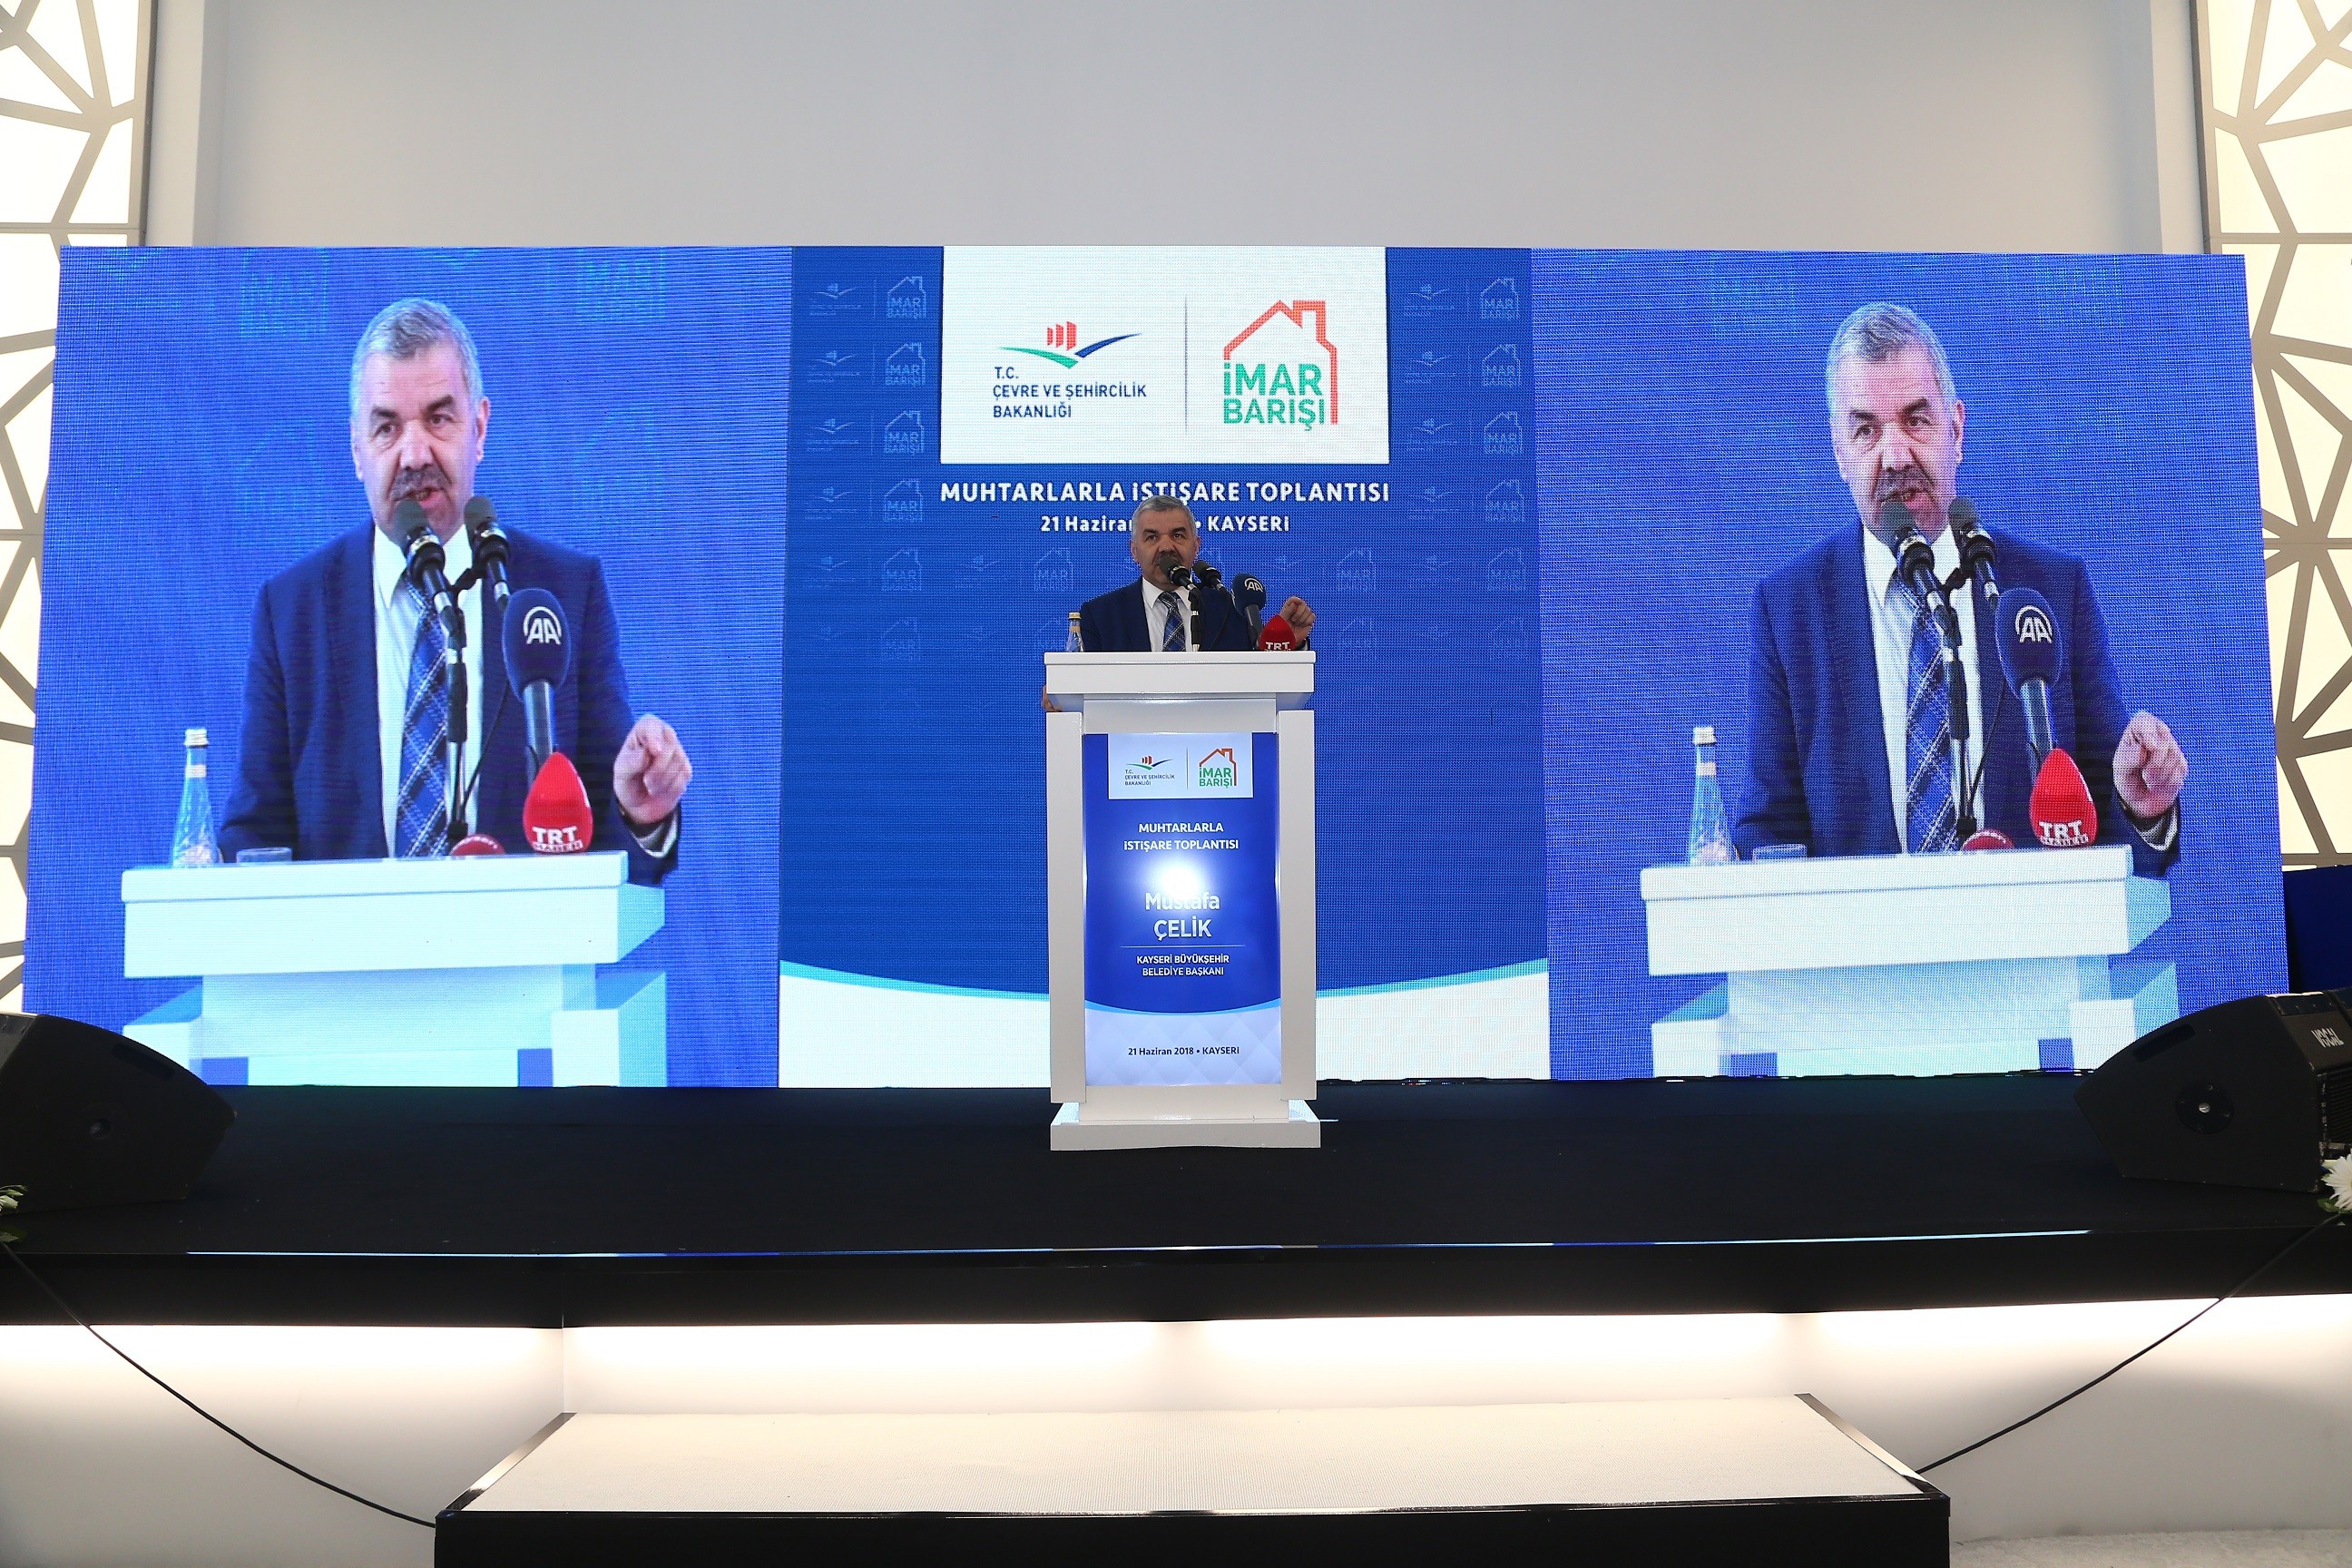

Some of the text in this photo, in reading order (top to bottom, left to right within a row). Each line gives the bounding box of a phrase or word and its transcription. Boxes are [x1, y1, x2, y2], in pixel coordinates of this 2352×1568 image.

[995, 367, 1019, 379] T.C.
[993, 381, 1147, 400] ÇEVRE VE ŞEHİRCİLİK
[993, 401, 1072, 417] BAKANLIĞI
[1224, 398, 1325, 431] BARIŞI
[940, 483, 1125, 502] MUHTARLARLA
[1246, 483, 1389, 502] TOPLANTISI
[1041, 514, 1289, 532] 21 Hazira KAYSERİ
[1247, 581, 1263, 593] AA
[526, 617, 561, 644] AA
[2019, 617, 2052, 643] AA
[1265, 642, 1289, 651] TRT
[1199, 779, 1233, 789] BARIŞI
[532, 826, 577, 845] TRT
[1139, 822, 1224, 833] MUHTARLARLA
[2038, 820, 2082, 840] TRT
[1174, 839, 1240, 850] TOPLANTISI
[1145, 892, 1220, 910] Mustafa
[1153, 916, 1212, 941] ÇELİK
[1137, 953, 1230, 965] KAYSERİ BÜYÜKŞEHİR
[1142, 965, 1224, 976] BELEDİYE BAŞKANI
[1128, 1047, 1137, 1055] 21
[1139, 1047, 1171, 1055] Haziran
[1173, 1047, 1194, 1055] 2018
